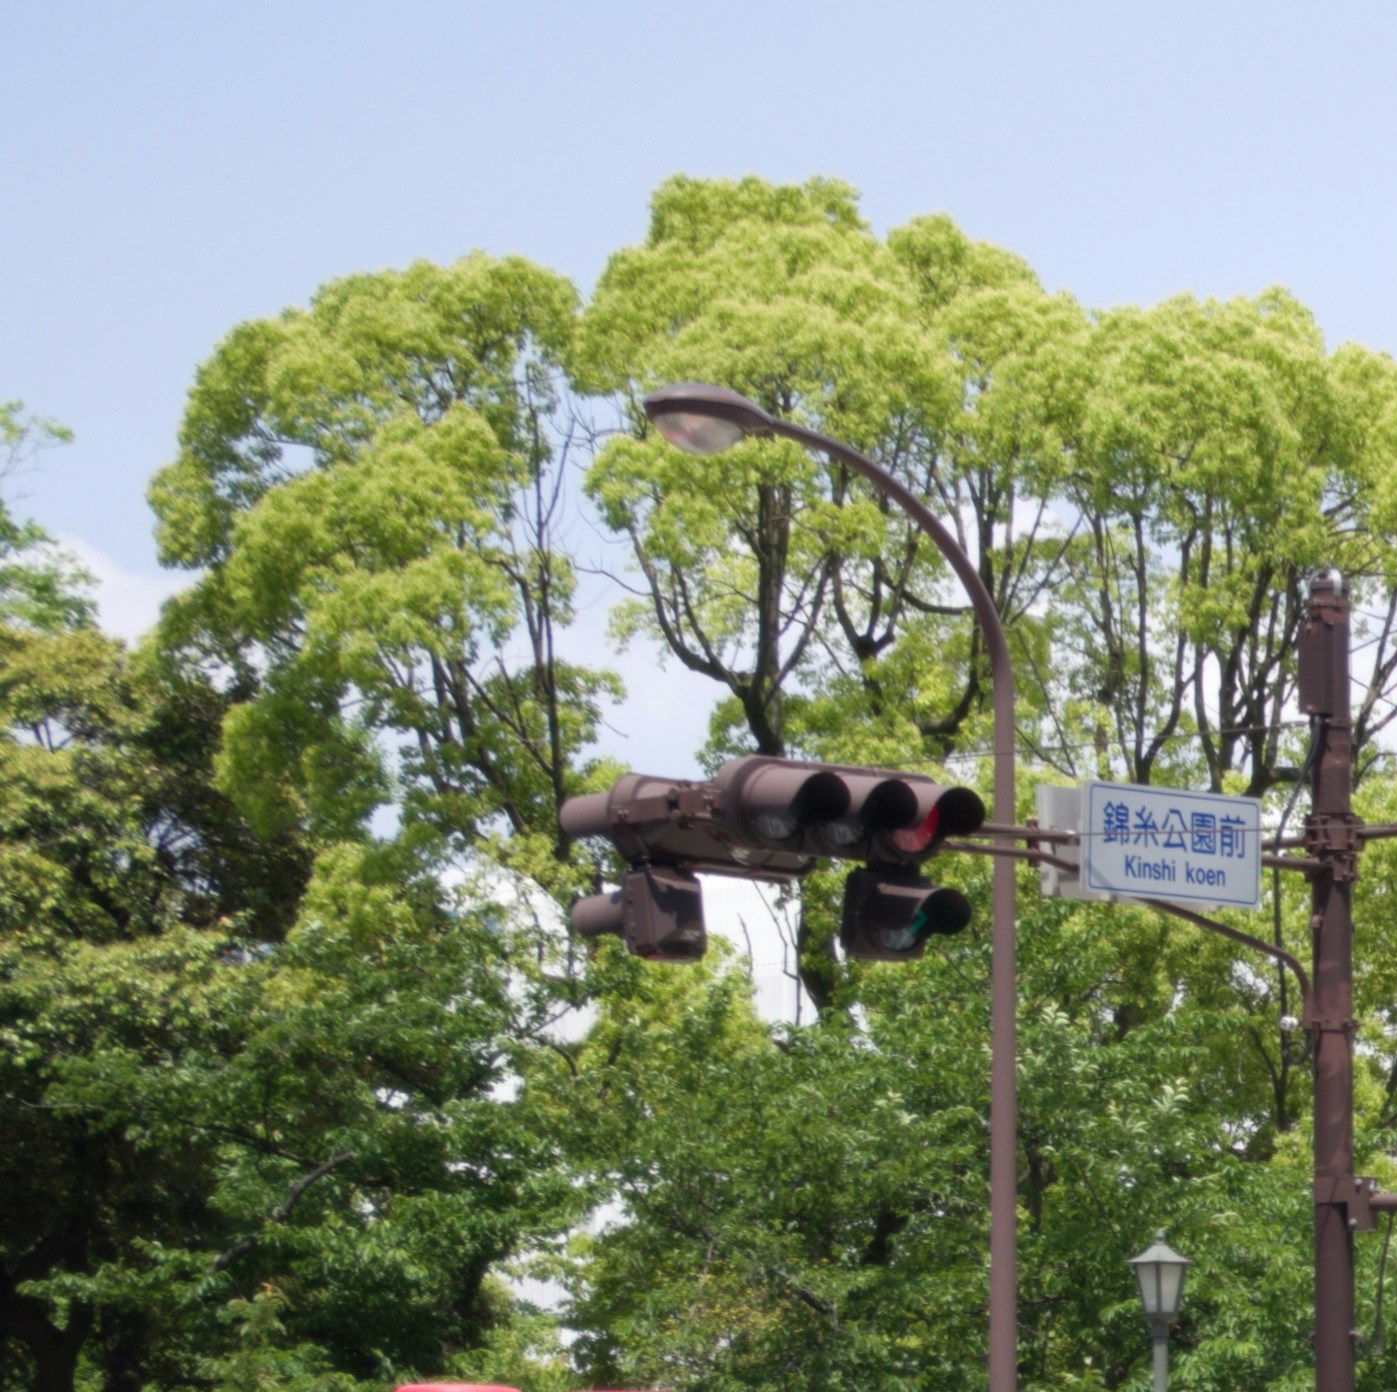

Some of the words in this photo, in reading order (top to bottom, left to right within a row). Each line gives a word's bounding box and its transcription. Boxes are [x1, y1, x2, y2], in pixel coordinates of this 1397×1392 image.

[1102, 799, 1247, 860] 錦糸公園前
[1124, 854, 1177, 884] Kinshi
[1185, 861, 1226, 888] koen
